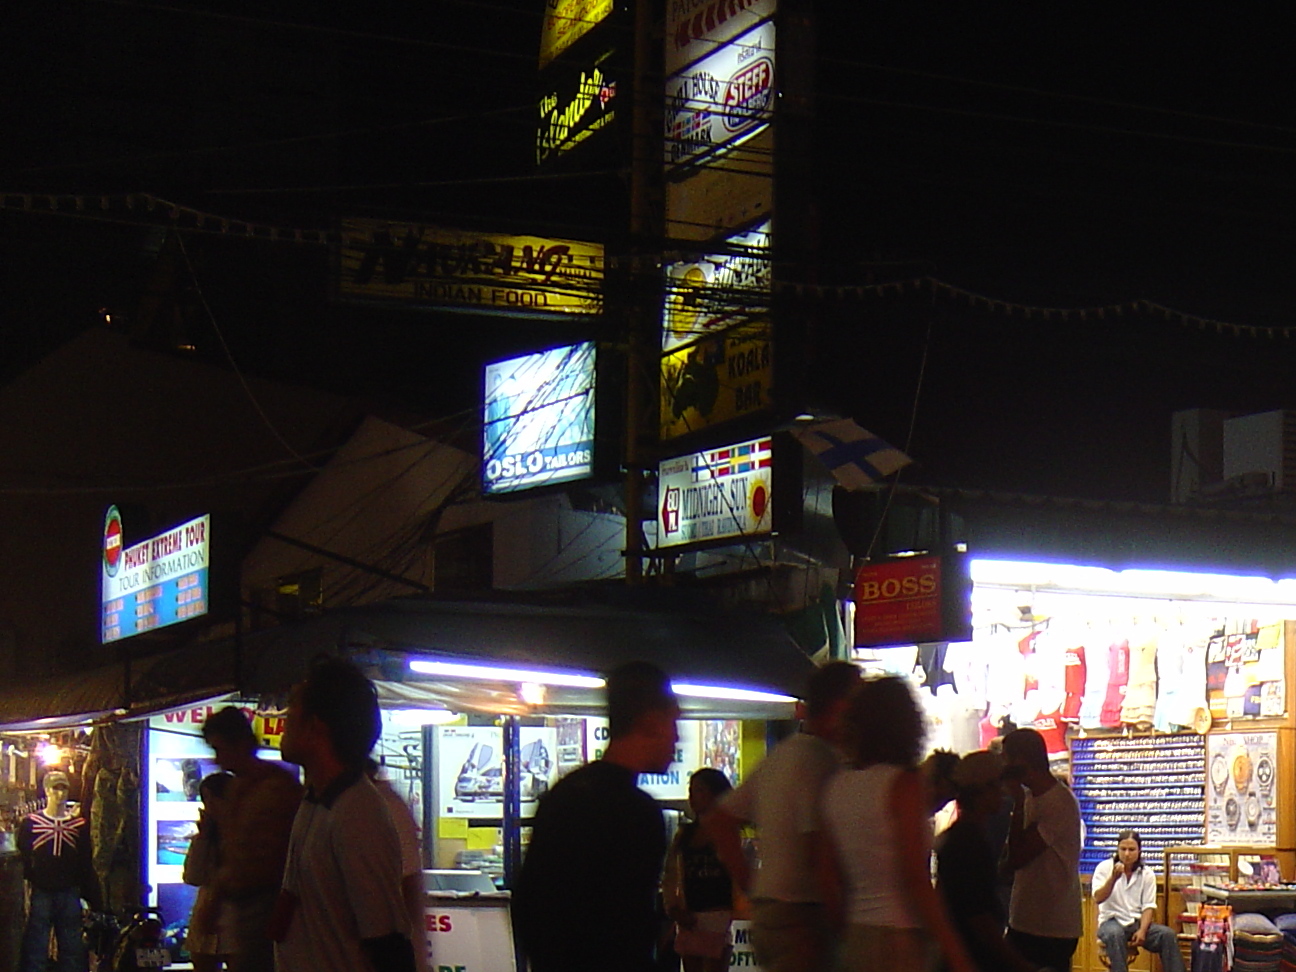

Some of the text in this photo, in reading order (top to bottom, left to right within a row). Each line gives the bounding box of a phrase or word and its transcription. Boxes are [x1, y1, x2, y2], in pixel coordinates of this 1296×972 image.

[727, 63, 767, 107] STEFF
[413, 281, 549, 307] INDIAN FOOD
[486, 451, 544, 480] OSLO
[545, 449, 591, 469] TAILORS
[682, 477, 748, 520] MIDNIGHT SUN
[124, 521, 205, 571] PHUKET EXTREME TOUR
[119, 549, 205, 592] TOUR INFORMATION
[861, 573, 937, 601] BOSS
[263, 716, 285, 735] LA
[640, 771, 680, 785] ATION
[425, 914, 453, 932] ES
